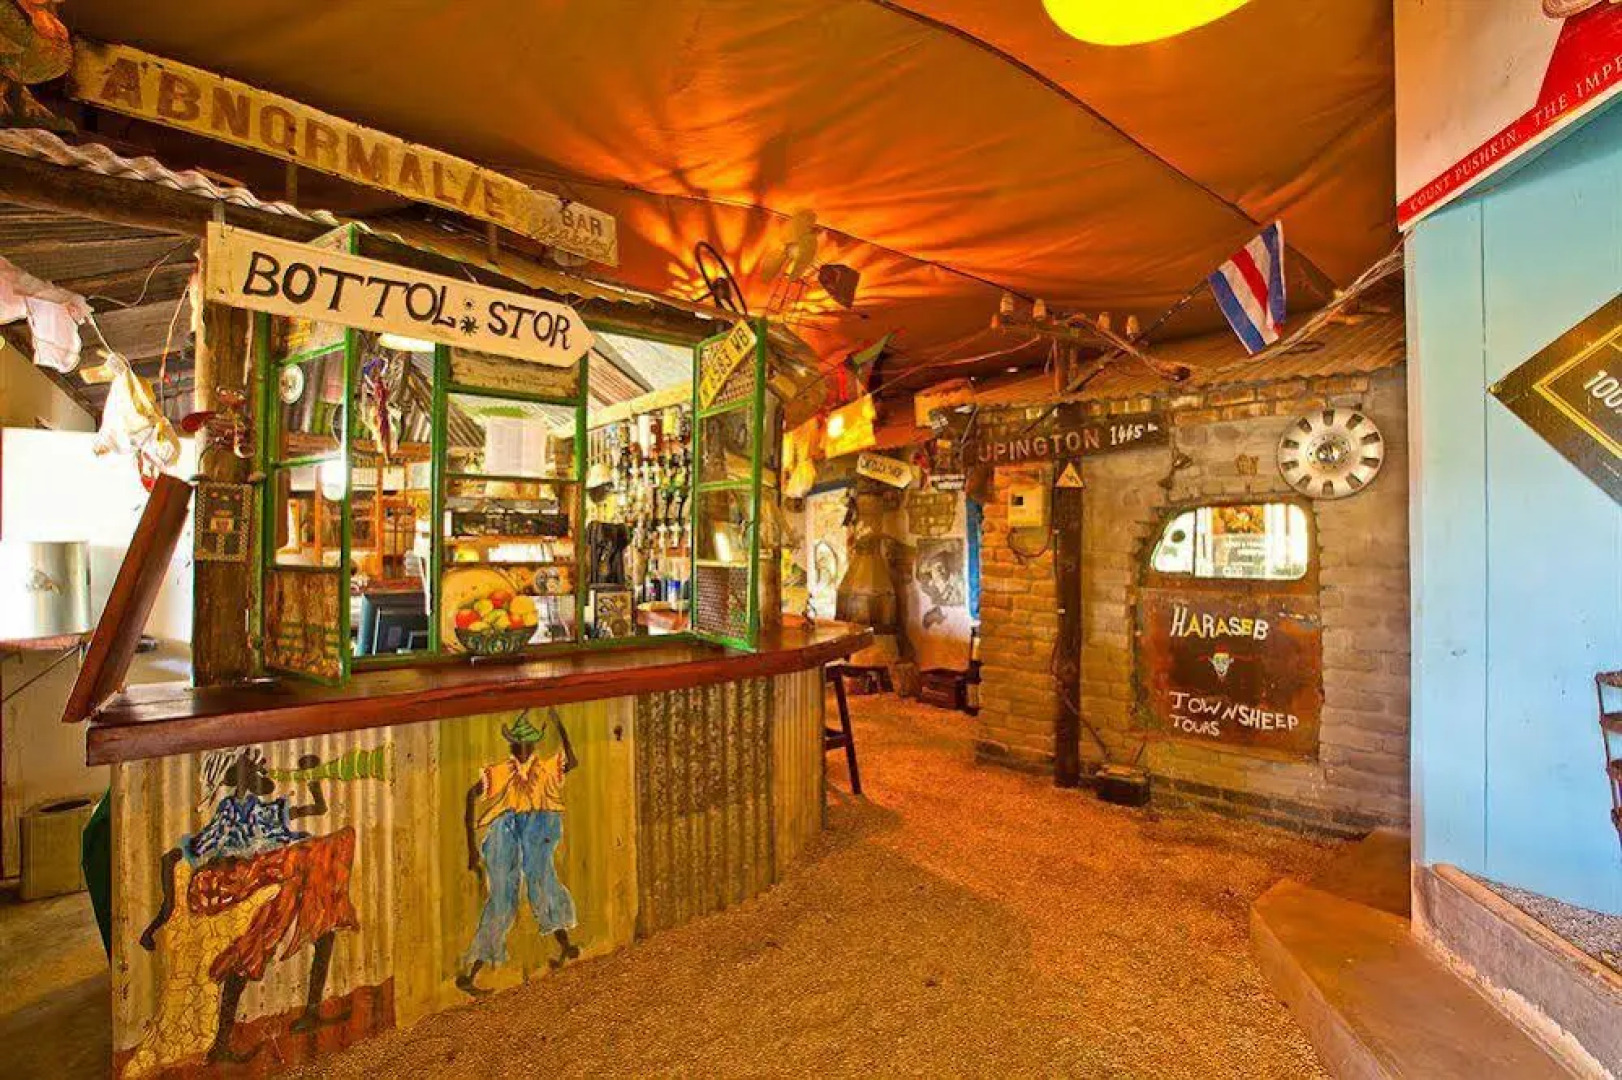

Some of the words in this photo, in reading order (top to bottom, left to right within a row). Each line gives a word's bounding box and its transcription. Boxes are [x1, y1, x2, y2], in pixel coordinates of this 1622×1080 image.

[1408, 176, 1453, 212] COUNT
[1532, 93, 1570, 128] THE
[560, 208, 603, 237] BAR
[487, 300, 572, 351] STOR
[978, 427, 1100, 462] UPINGTON
[1169, 604, 1269, 641] HARASEB
[1169, 714, 1221, 737] TOURS
